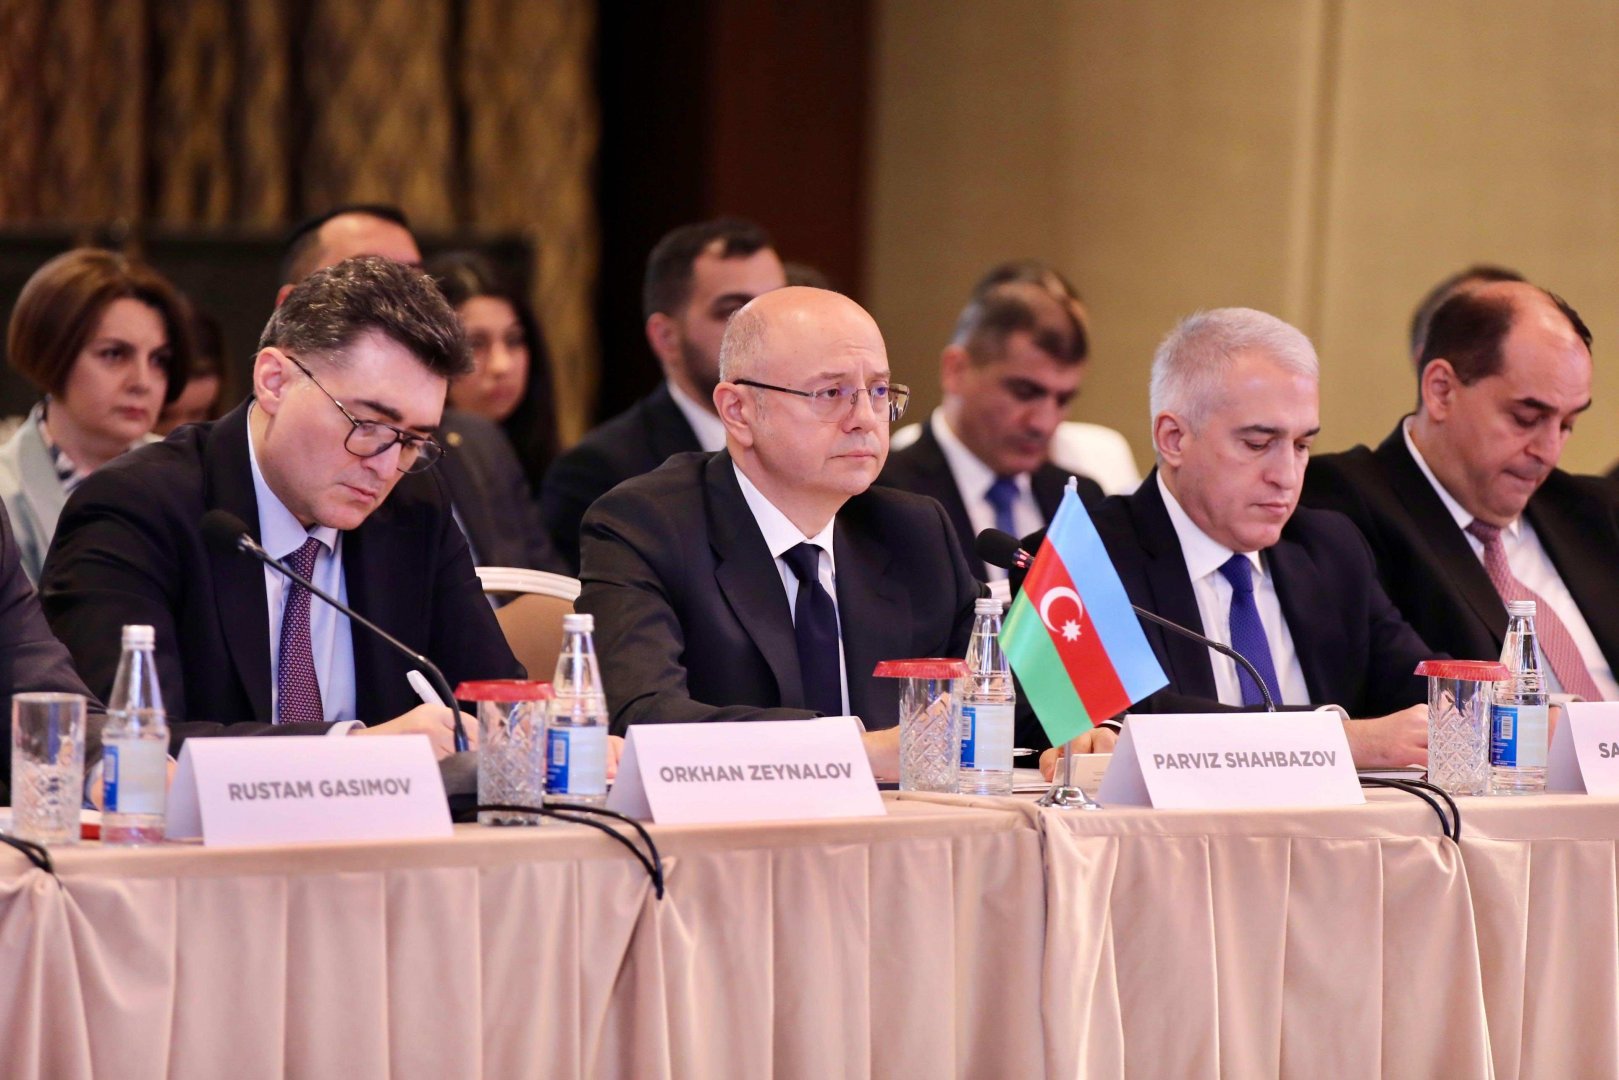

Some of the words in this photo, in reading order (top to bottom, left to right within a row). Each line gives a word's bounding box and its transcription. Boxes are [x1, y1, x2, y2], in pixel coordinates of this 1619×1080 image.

[1153, 752, 1221, 770] PARVIZ
[1224, 751, 1336, 769] SHAHBAZOV
[659, 765, 745, 783] ORKHAN
[747, 763, 852, 781] ZEYNALOV
[228, 781, 314, 801] RUSTAM
[318, 778, 411, 798] GASIMOV
